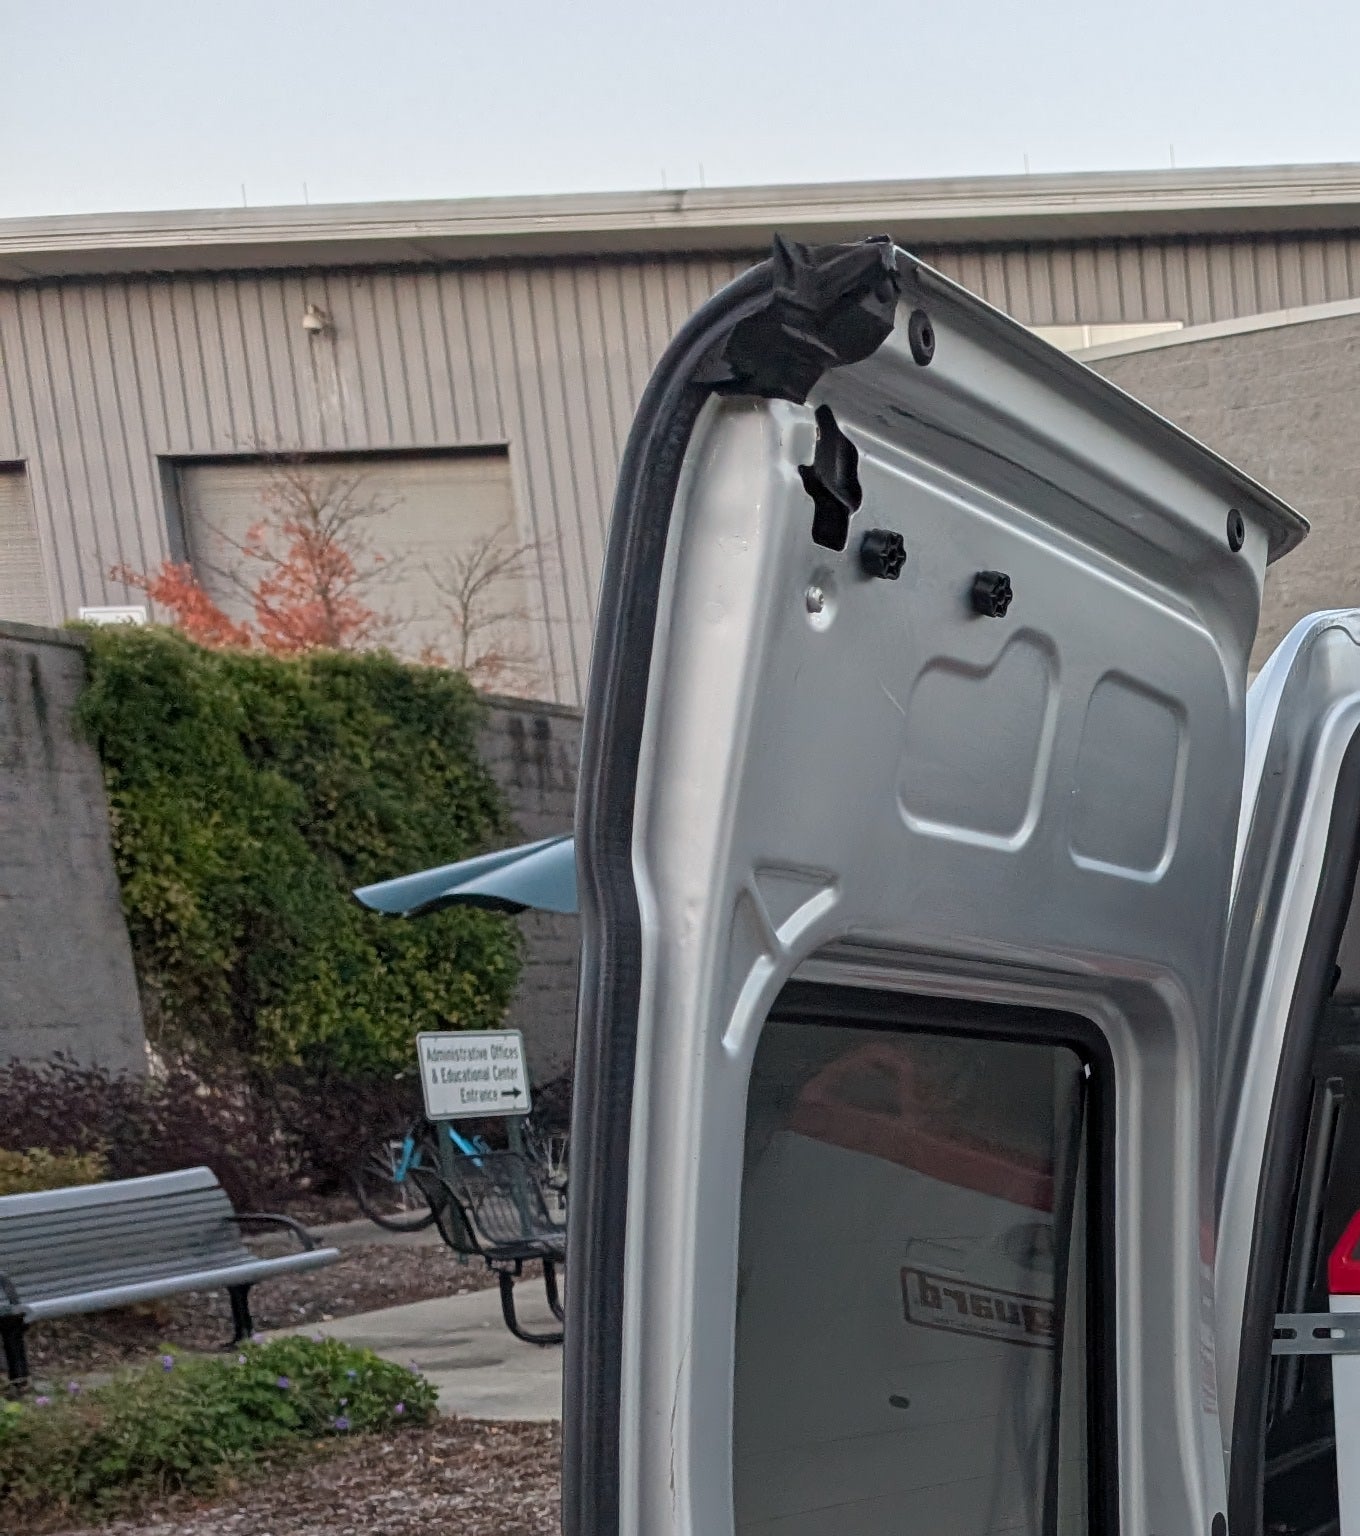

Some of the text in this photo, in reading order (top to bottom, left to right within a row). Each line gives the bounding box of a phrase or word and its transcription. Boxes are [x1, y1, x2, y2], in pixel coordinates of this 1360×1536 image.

[490, 1044, 519, 1060] Offices
[440, 1067, 490, 1084] Educational
[492, 1065, 518, 1081] Center
[460, 1087, 498, 1104] Entrance
